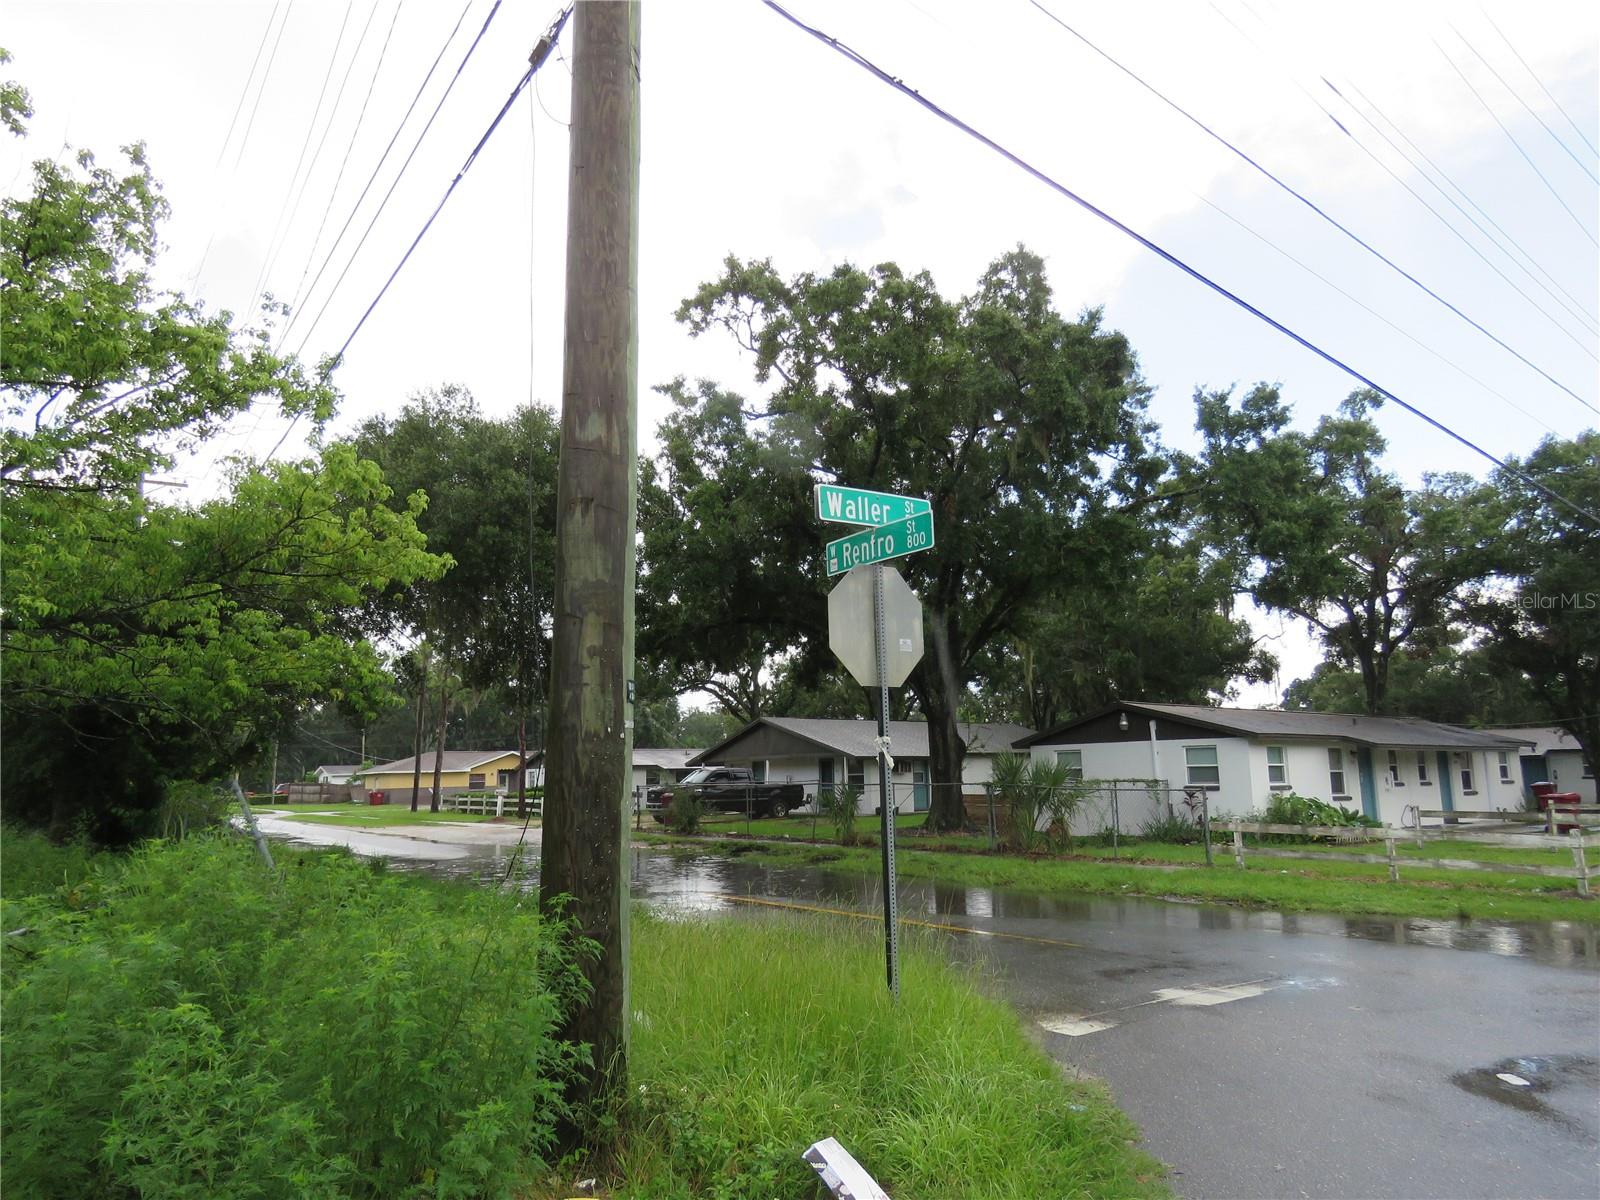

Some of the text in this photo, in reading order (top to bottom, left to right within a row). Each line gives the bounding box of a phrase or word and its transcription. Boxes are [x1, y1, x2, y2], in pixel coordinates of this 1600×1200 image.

[826, 491, 915, 523] Waller St
[842, 534, 894, 567] Renfro
[906, 520, 916, 533] St
[907, 532, 926, 548] 800
